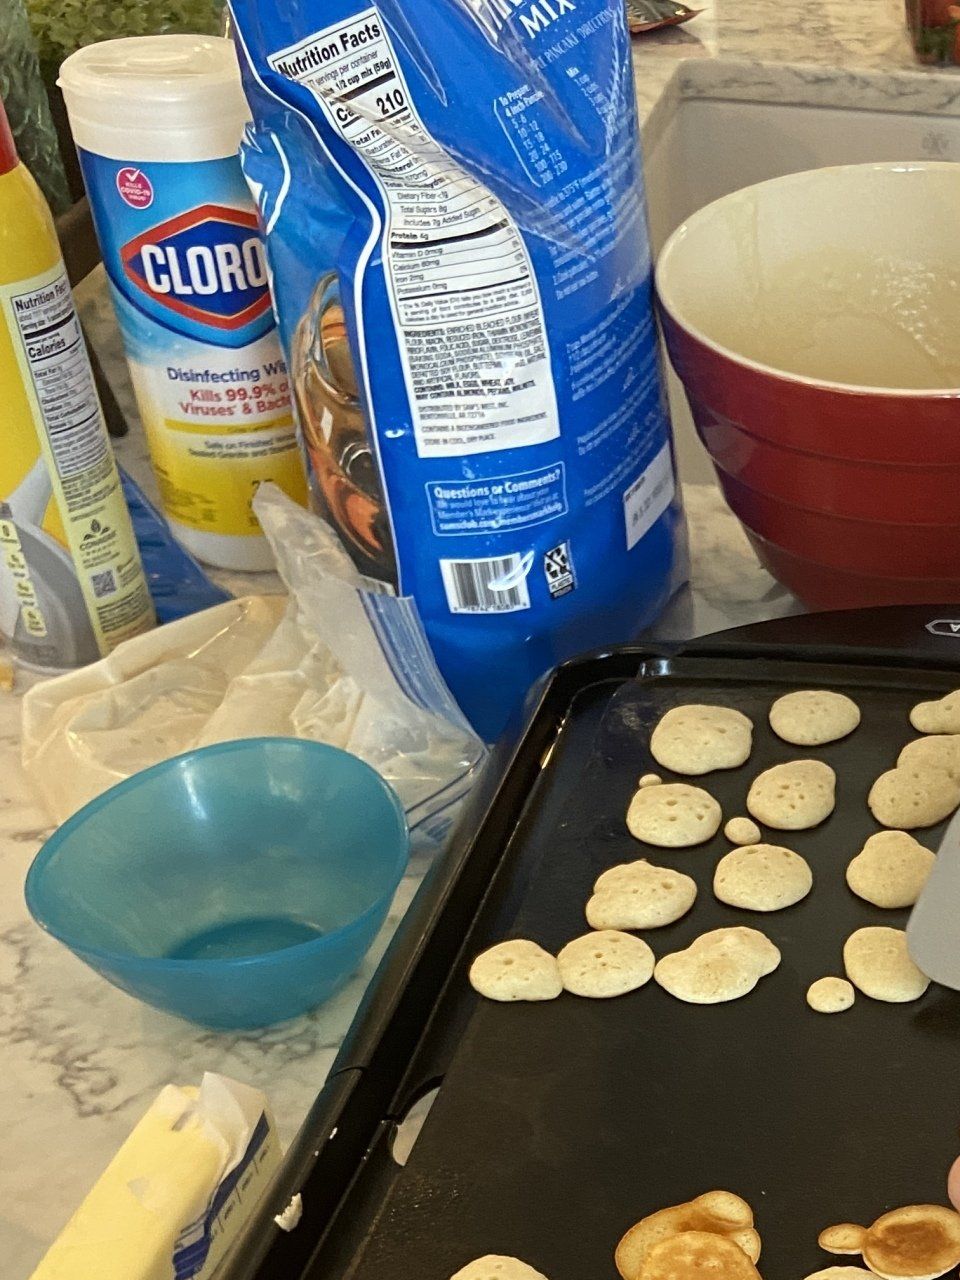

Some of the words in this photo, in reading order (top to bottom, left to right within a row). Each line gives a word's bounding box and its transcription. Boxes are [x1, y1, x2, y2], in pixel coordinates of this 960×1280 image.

[277, 43, 340, 78] Nutrition
[339, 23, 381, 54] Facts
[316, 68, 339, 86] servings
[339, 64, 350, 76] per
[350, 50, 378, 68] container
[335, 80, 348, 91] 1/2
[347, 74, 360, 87] cup
[361, 68, 373, 78] mix
[374, 58, 392, 74] (59g)
[376, 89, 404, 115] 210
[140, 237, 268, 295] CLORO
[14, 293, 55, 312] Nutrition
[28, 337, 66, 359] Calories
[166, 367, 261, 383] Disinfecting
[190, 388, 221, 403] Kills
[225, 383, 276, 401] 99.9%
[242, 405, 252, 415] &
[434, 485, 489, 499] Questions
[491, 485, 503, 494] or
[504, 468, 561, 494] Comments?
